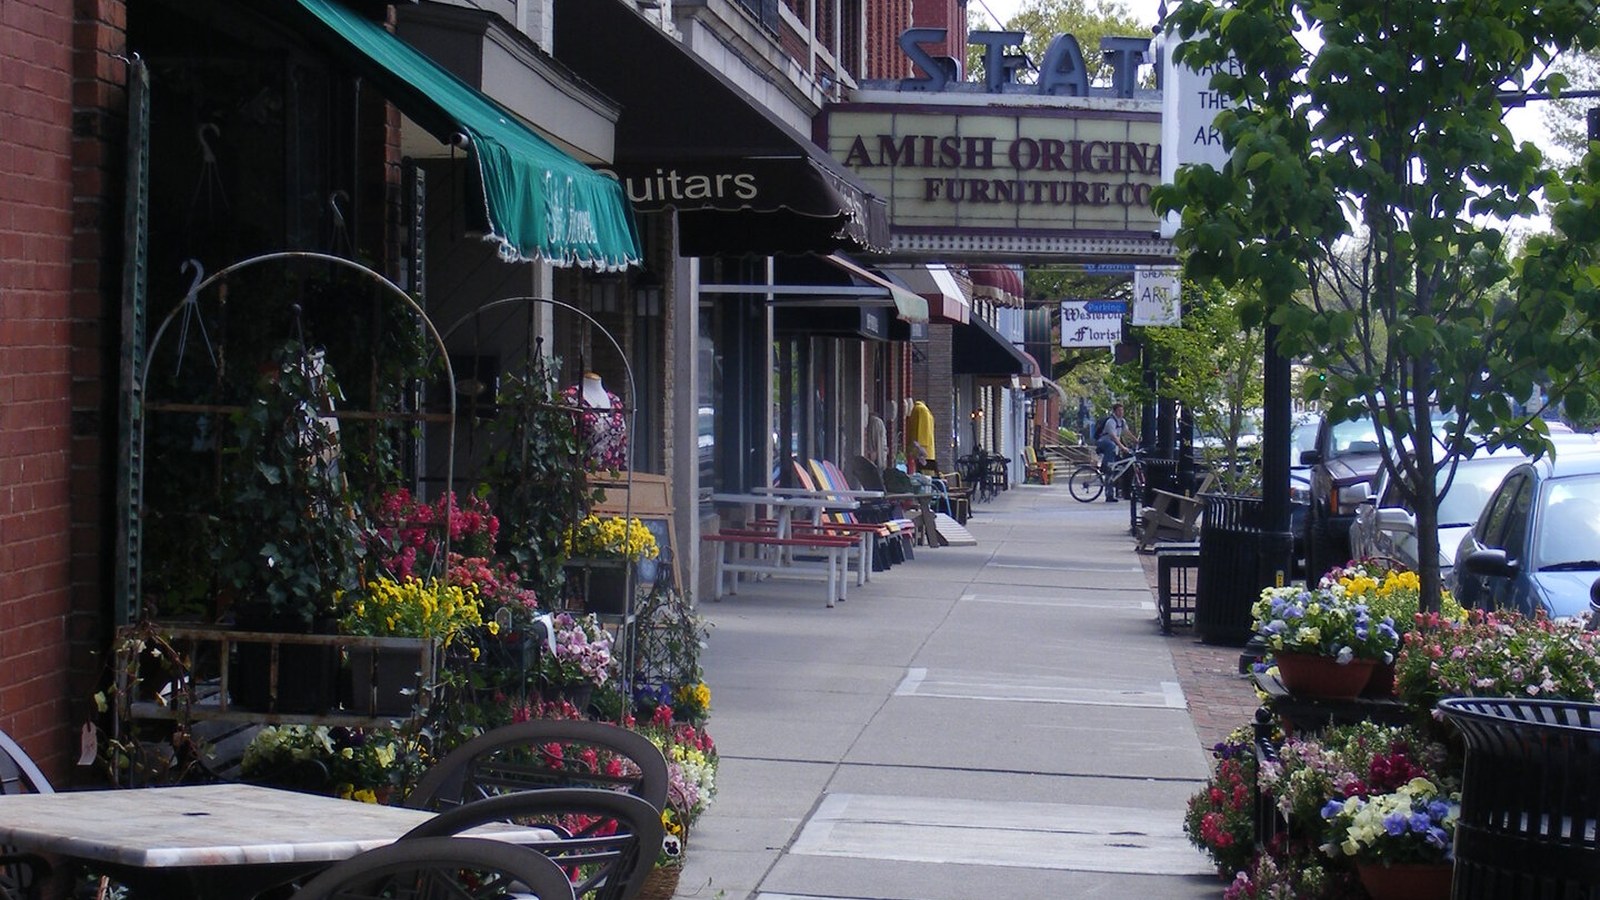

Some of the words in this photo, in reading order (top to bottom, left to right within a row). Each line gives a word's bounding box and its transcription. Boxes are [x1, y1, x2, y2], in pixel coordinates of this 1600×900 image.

[900, 27, 1163, 99] STAT
[1198, 91, 1229, 109] THE
[1193, 124, 1221, 146] AR
[842, 134, 997, 170] AMISH
[1008, 136, 1161, 176] ORIGINA
[597, 167, 758, 203] uitars
[924, 177, 1110, 207] FURNITURE
[1141, 286, 1170, 303] ART
[1069, 326, 1121, 343] Florist
